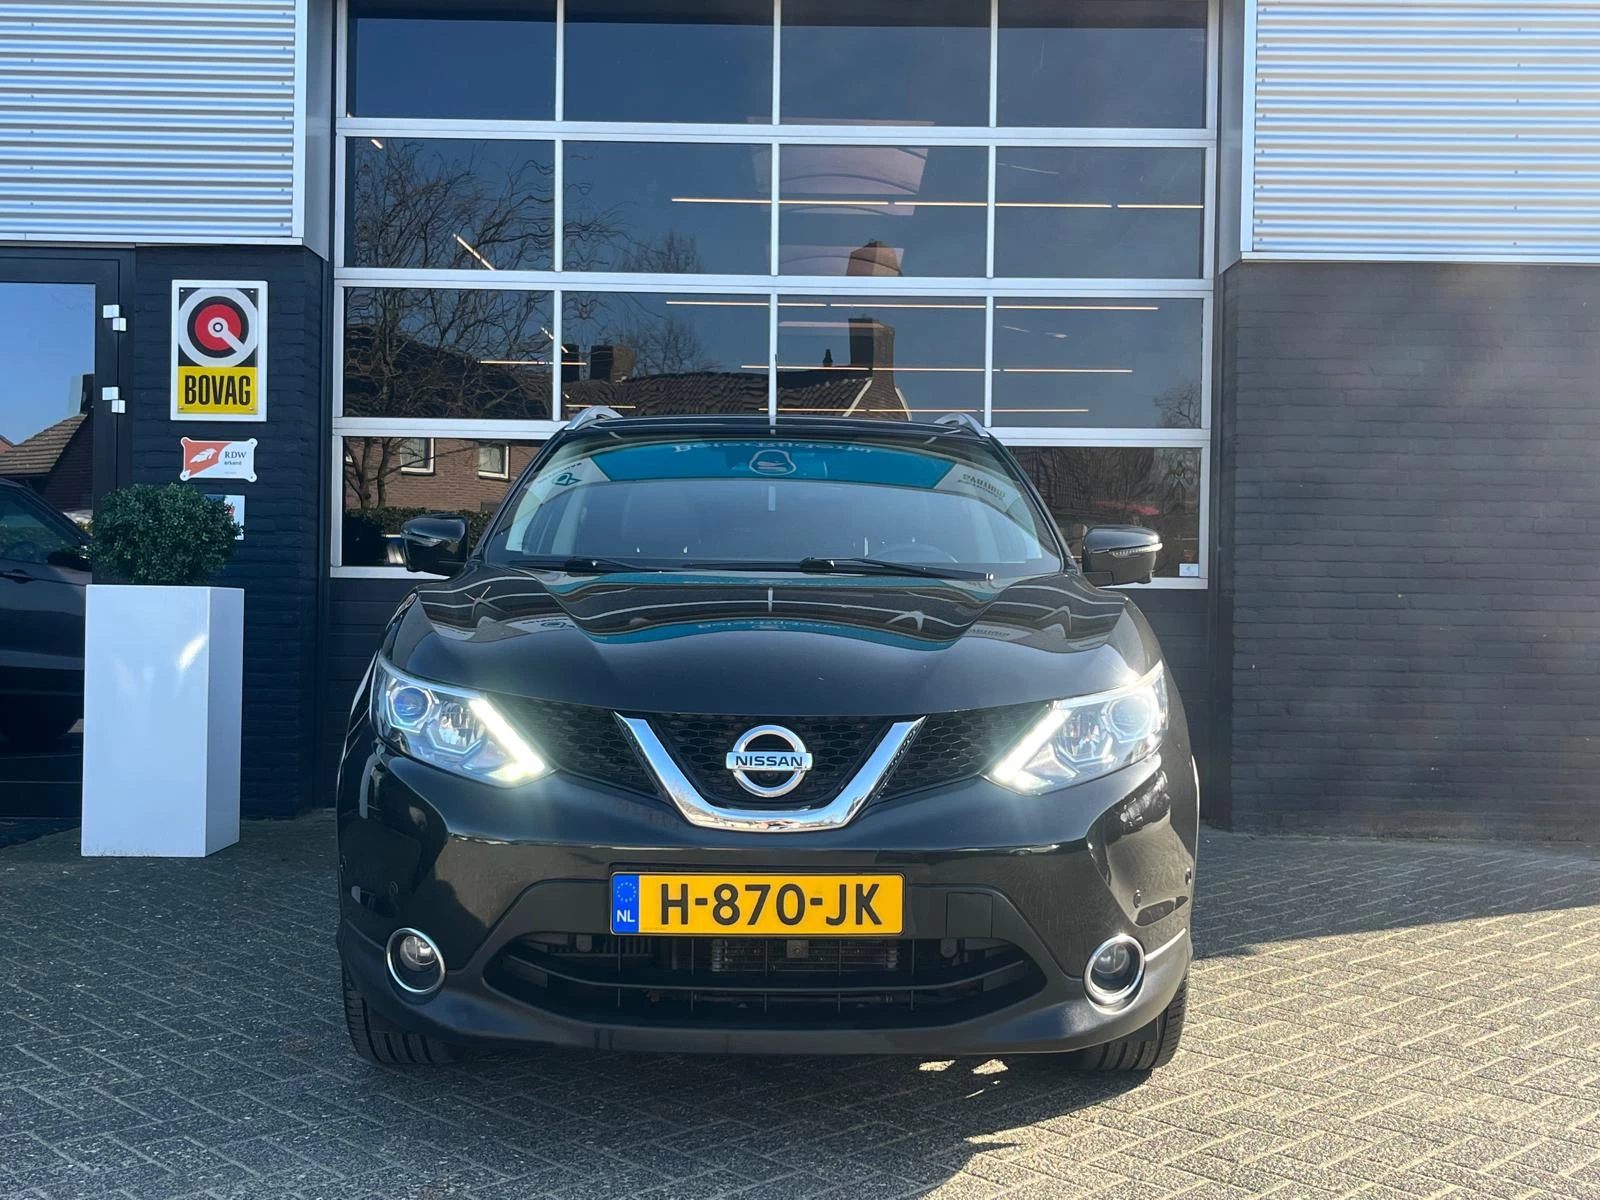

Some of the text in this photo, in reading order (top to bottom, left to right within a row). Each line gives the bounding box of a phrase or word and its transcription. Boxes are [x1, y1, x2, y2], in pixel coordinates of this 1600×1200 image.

[184, 376, 251, 406] BOVAG
[224, 451, 247, 459] RDW
[735, 755, 803, 767] NISSAN
[661, 883, 883, 926] H-870-JK
[617, 910, 635, 923] NL
